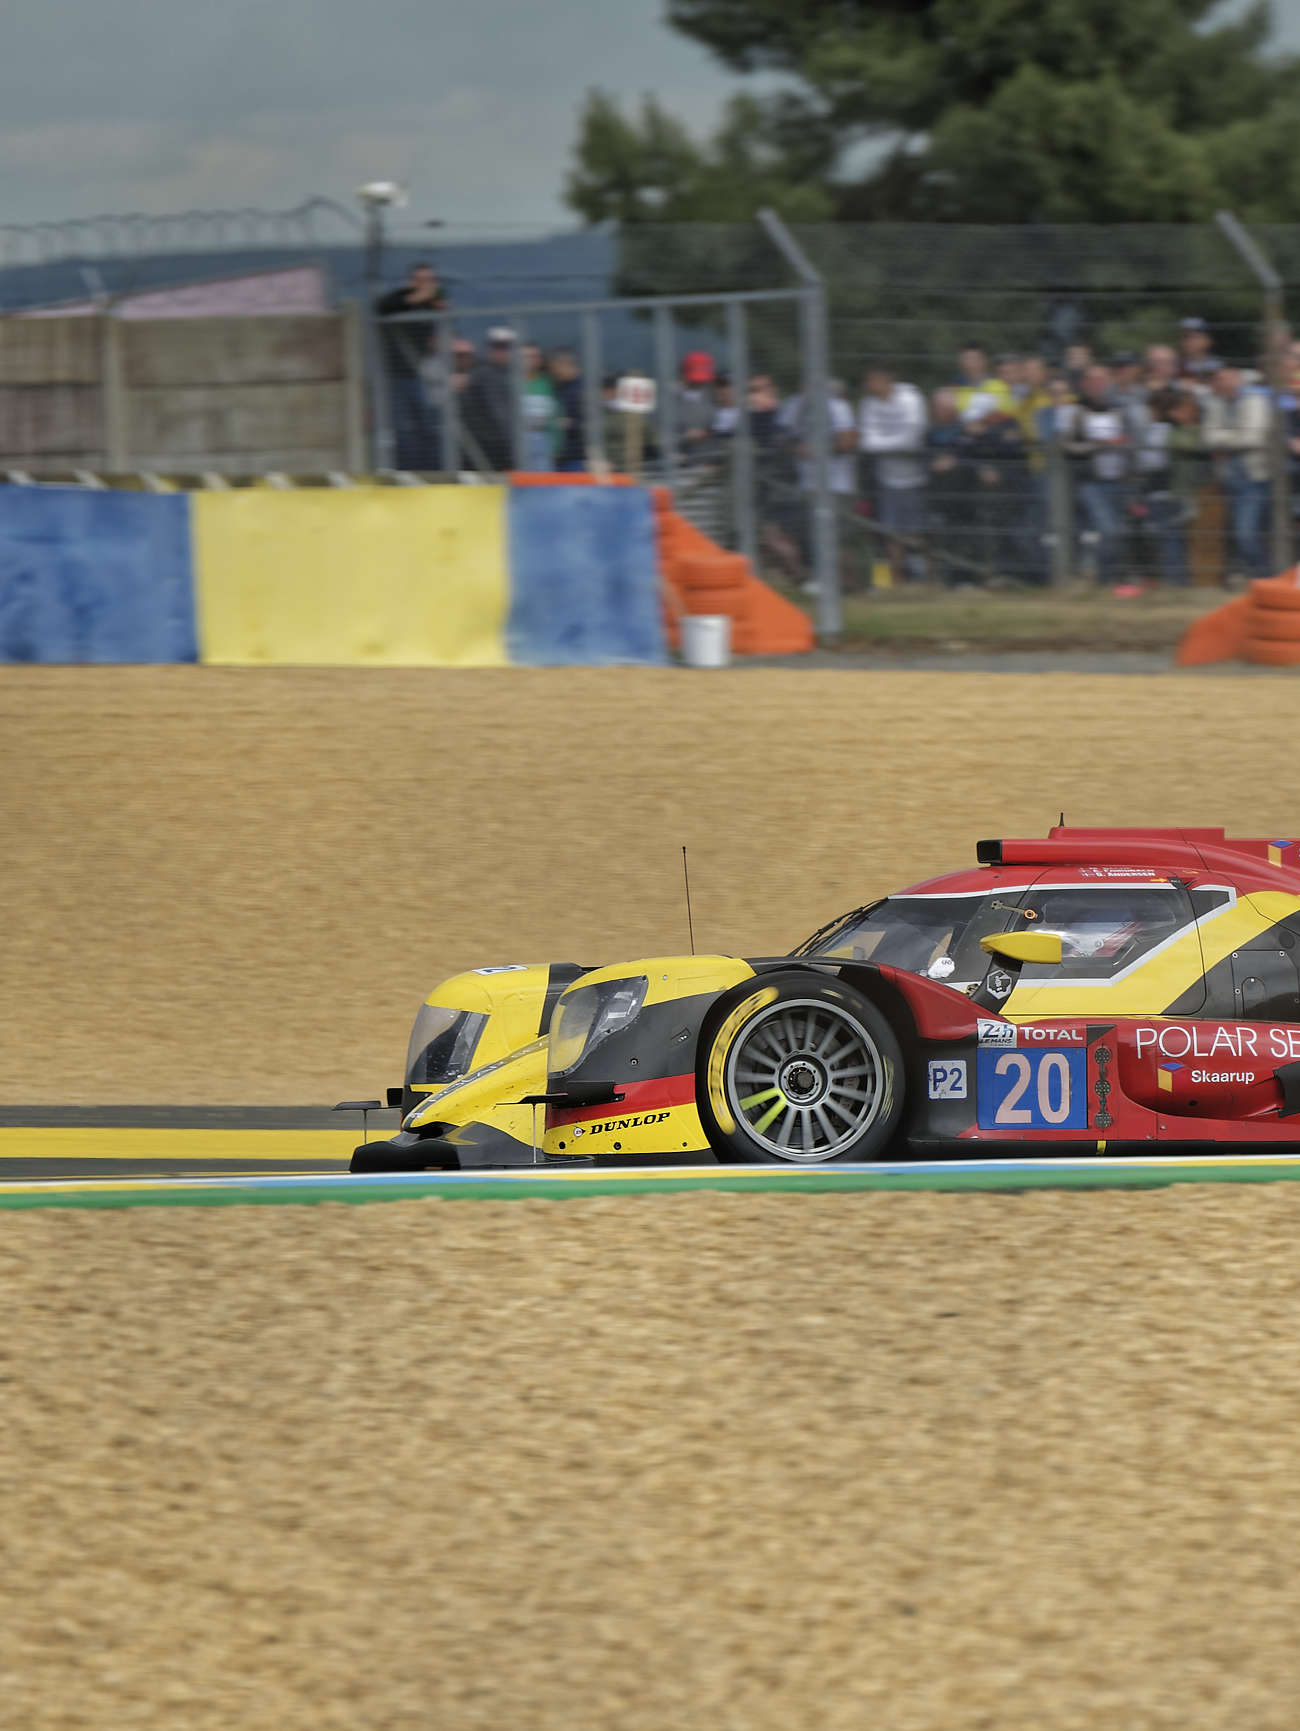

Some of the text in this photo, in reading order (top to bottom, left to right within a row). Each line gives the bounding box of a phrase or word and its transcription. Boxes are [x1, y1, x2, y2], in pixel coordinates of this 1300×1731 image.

[1020, 1026, 1083, 1041] TOTAL
[1136, 1026, 1258, 1059] POLAR
[932, 1067, 963, 1092] P2
[994, 1053, 1071, 1124] 20
[1191, 1070, 1255, 1084] Skaarup
[590, 1112, 670, 1135] DUNLOP
